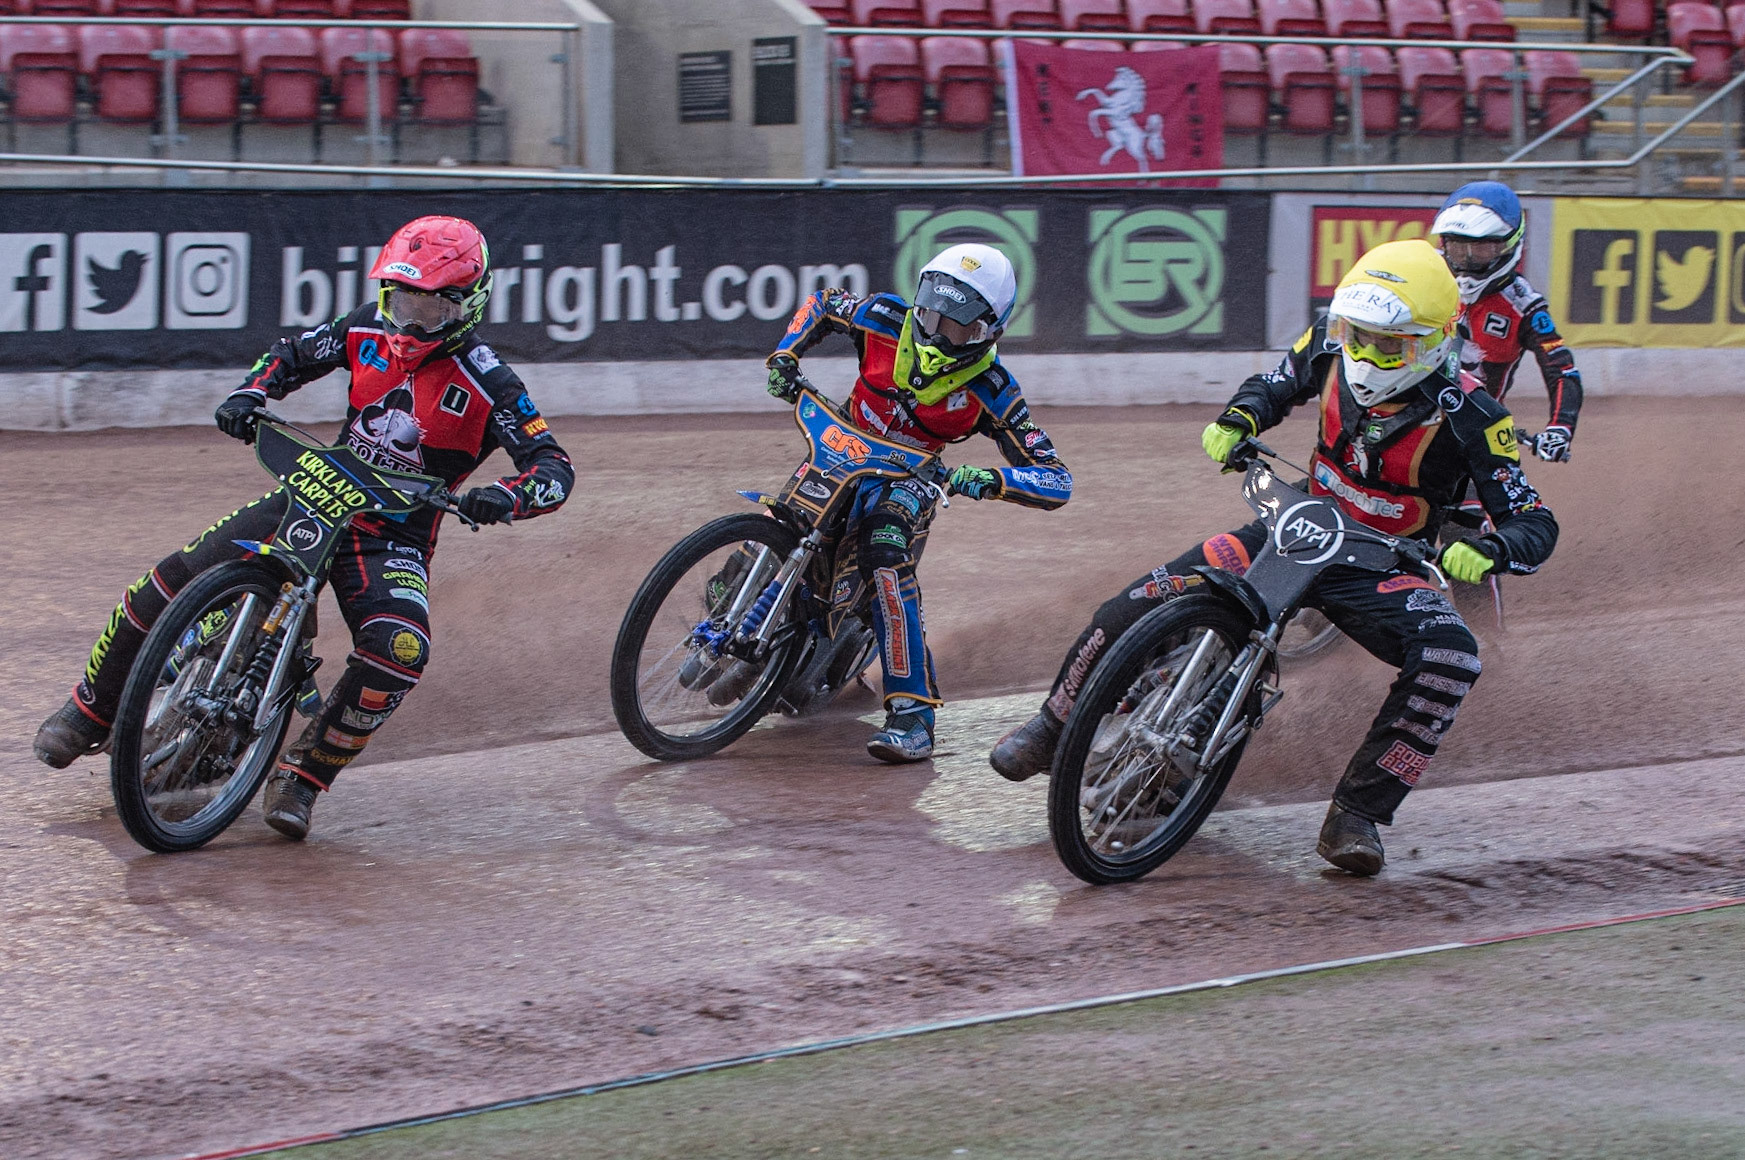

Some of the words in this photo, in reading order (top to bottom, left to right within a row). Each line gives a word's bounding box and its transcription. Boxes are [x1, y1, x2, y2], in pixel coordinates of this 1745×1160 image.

[938, 286, 963, 301] SHOEI
[1486, 313, 1507, 336] 2
[288, 470, 349, 518] CARPETS
[296, 450, 367, 506] KIRKLAND
[1328, 475, 1405, 518] TouchTec
[292, 527, 316, 542] ATPI
[1285, 516, 1333, 549] ATPI
[881, 574, 900, 617] MARK
[891, 619, 905, 670] PARSONS
